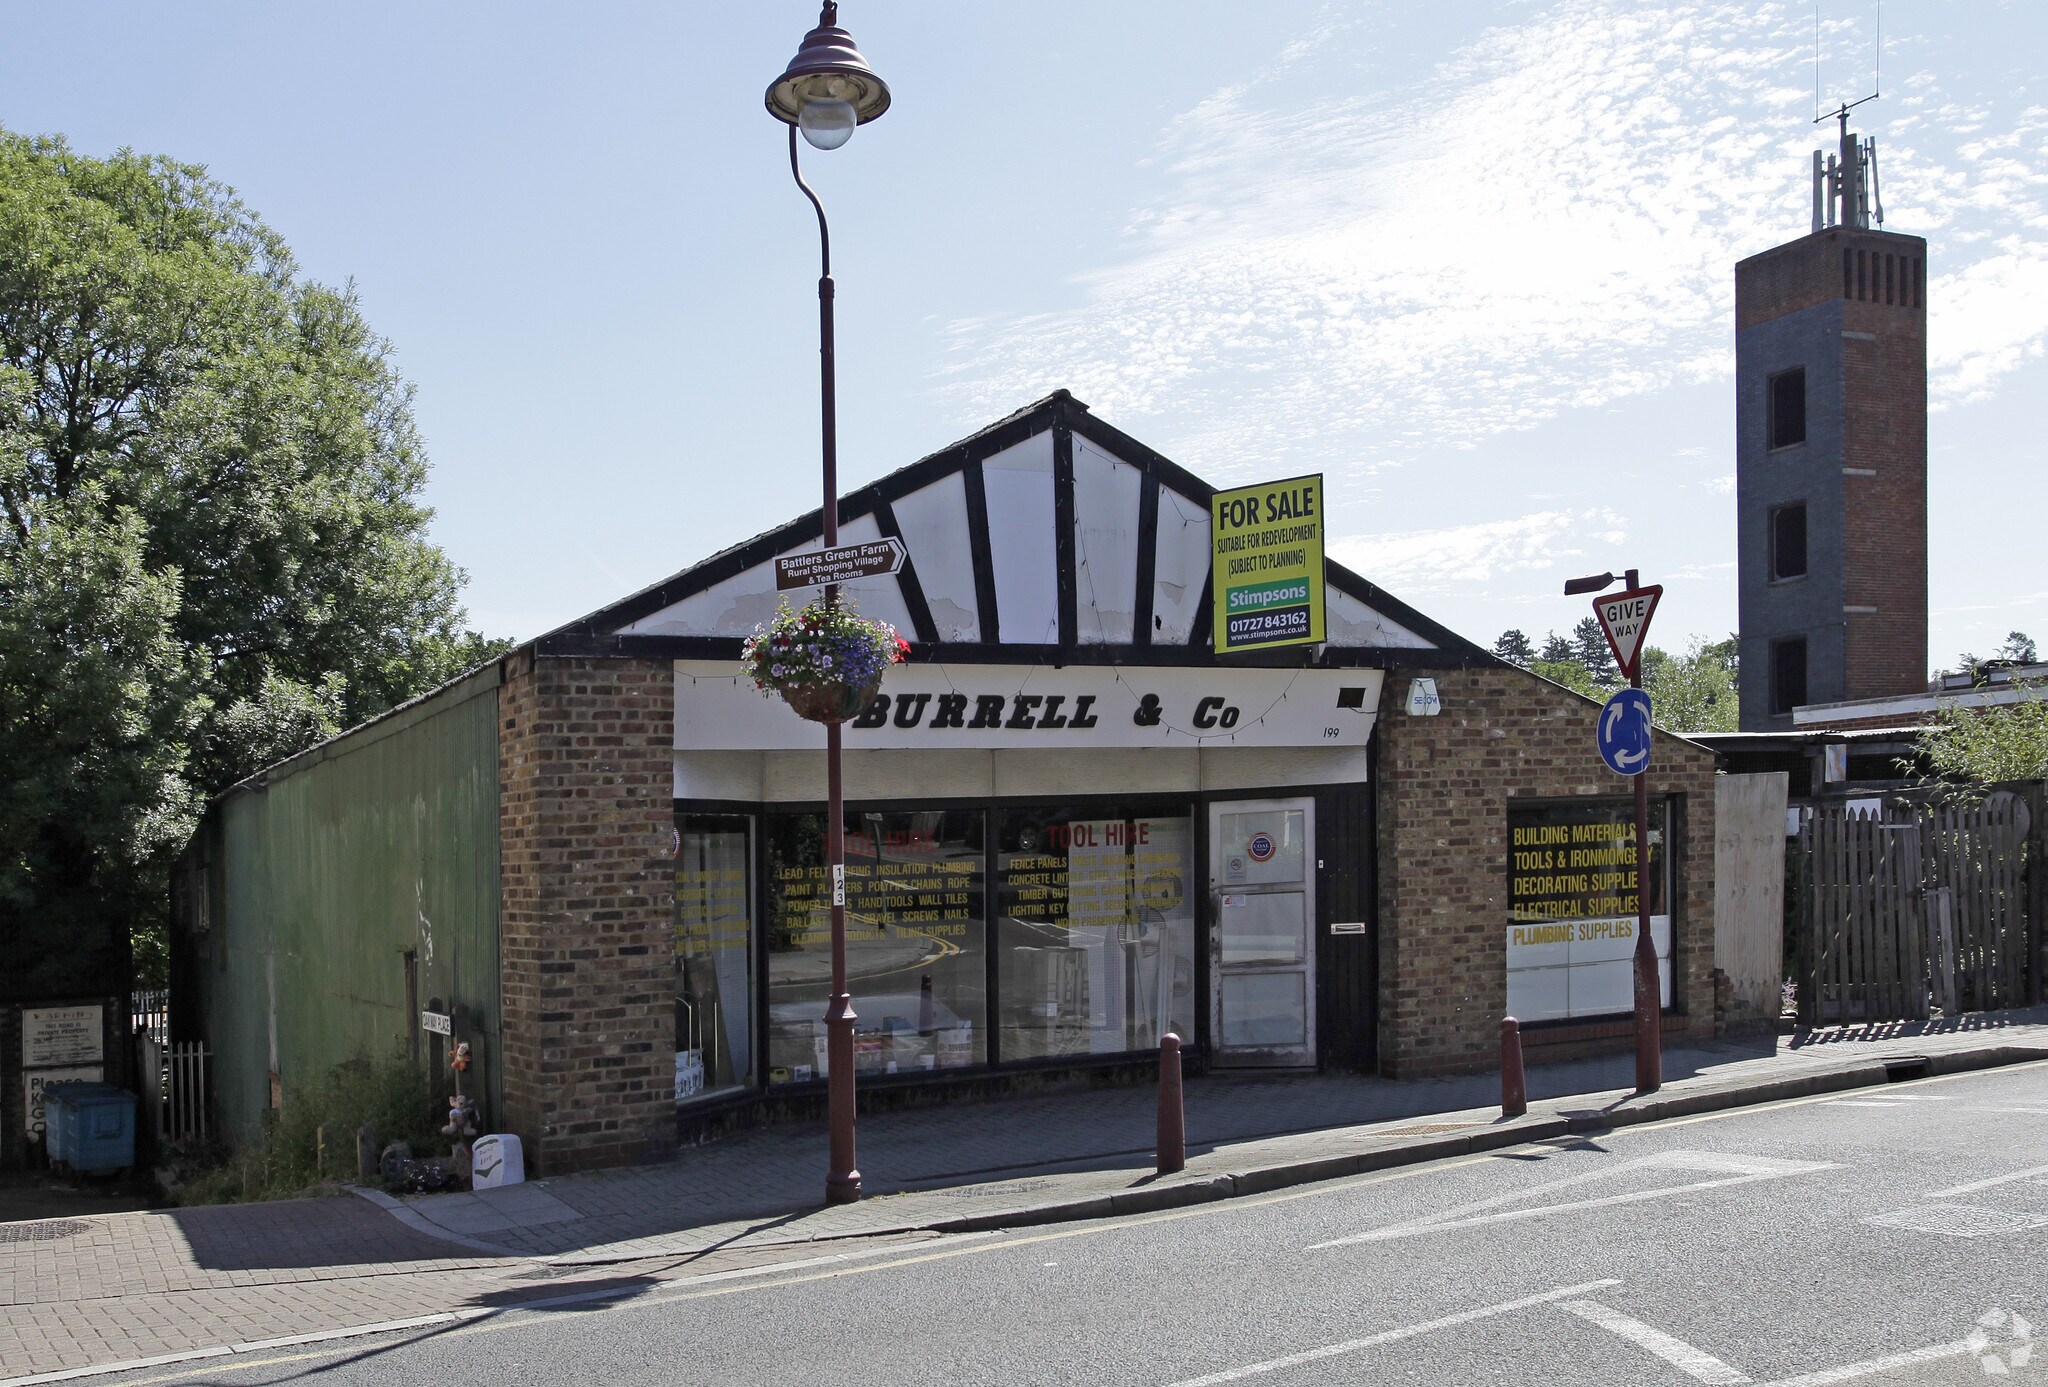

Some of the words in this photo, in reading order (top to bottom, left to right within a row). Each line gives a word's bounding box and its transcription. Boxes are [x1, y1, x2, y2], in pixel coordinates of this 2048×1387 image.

[1220, 497, 1260, 530] FOR
[1266, 487, 1314, 522] SALE
[1218, 534, 1245, 554] SUITABLE
[1248, 532, 1260, 549] FOR
[1262, 524, 1316, 546] REDEVELOPMENT
[781, 555, 822, 570] Battlers
[826, 549, 858, 562] Green
[861, 544, 888, 555] Farm
[788, 568, 810, 578] Rural
[812, 561, 853, 573] Shopping
[854, 556, 884, 566] Village
[1228, 556, 1257, 578] (SUBJECT
[1259, 554, 1267, 570] TO
[1269, 548, 1306, 568] PLANNING)
[816, 574, 831, 583] Tea
[834, 569, 864, 581] Rooms
[1230, 586, 1306, 606] Stimpsons
[1607, 600, 1644, 622] GIVE
[1230, 618, 1263, 632] 01727
[1265, 612, 1306, 628] 843162
[1615, 623, 1639, 638] WAY
[1231, 625, 1306, 640] www.stimpsons.co.uk
[852, 694, 1098, 729] BURRELL
[1134, 693, 1162, 726] &
[1192, 696, 1240, 728] Co
[1323, 727, 1340, 738] 199
[1047, 824, 1098, 848] TOOL
[1106, 822, 1148, 846] HIRE
[1514, 826, 1568, 846] BUILDING
[1572, 823, 1636, 843] MATERIALS
[1010, 858, 1035, 870] FENCE
[1038, 857, 1067, 868] PANELS
[1514, 851, 1553, 870] TOOLS
[1558, 852, 1566, 868] &
[1571, 846, 1653, 867] IRONMONGEY
[780, 867, 802, 880] LEAD
[809, 866, 828, 878] FELT
[877, 864, 926, 876] INSULATION
[932, 861, 975, 874] PLUMBING
[1008, 874, 1050, 886] CONCRETE
[785, 884, 811, 895] PAINT
[911, 878, 942, 890] CHAINS
[948, 877, 970, 888] ROPE
[1514, 874, 1587, 896] DECORATING
[1592, 871, 1638, 891] SUPPLIE
[788, 900, 821, 911] POWER
[858, 898, 882, 908] HAND
[885, 895, 913, 907] TOOLS
[919, 894, 942, 905] WALL
[945, 893, 968, 904] TILES
[1018, 889, 1047, 900] TIMBER
[787, 916, 826, 928] BALLAST
[903, 910, 939, 922] SCREWS
[944, 908, 969, 920] NAILS
[1008, 905, 1045, 916] LIGHTING
[1049, 903, 1064, 914] KEY
[1514, 899, 1584, 921] ELECTRICAL
[896, 928, 922, 939] TILING
[926, 925, 966, 937] SUPPLIES
[1513, 923, 1574, 945] PLUMBING
[1579, 920, 1632, 940] SUPPLIES
